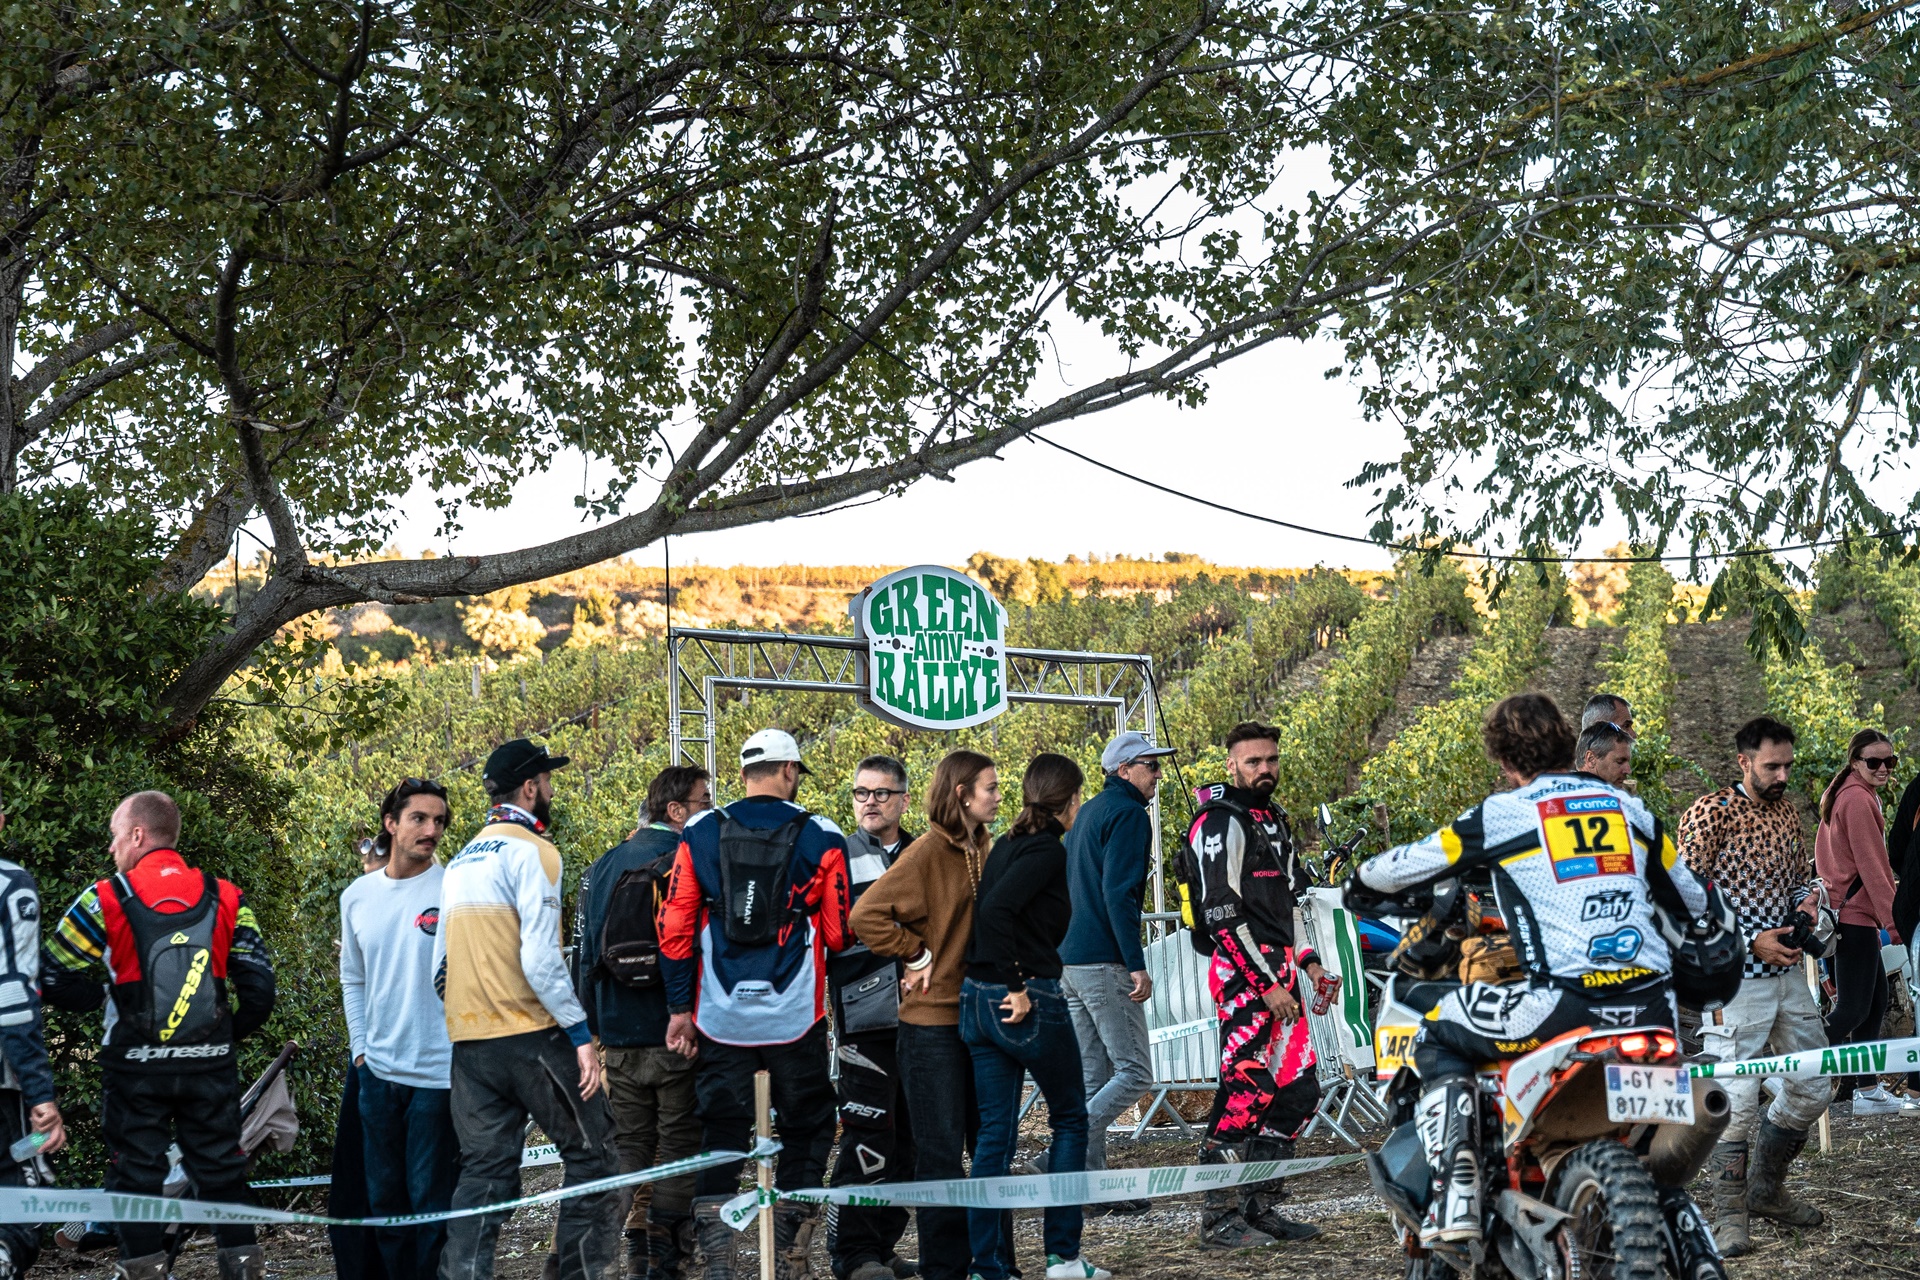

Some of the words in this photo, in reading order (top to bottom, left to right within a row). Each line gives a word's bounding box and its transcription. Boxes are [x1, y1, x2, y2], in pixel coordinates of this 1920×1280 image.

[870, 574, 1000, 643] GREEN
[914, 632, 963, 661] AMV
[874, 650, 1001, 721] RALLYE
[1568, 799, 1619, 812] aramco
[1564, 816, 1615, 855] 12
[743, 879, 756, 926] NATHAN
[1204, 903, 1237, 925] FOX
[1582, 899, 1633, 922] Dafy
[1588, 931, 1639, 960] S3
[158, 948, 210, 1042] ACERBIS
[125, 1043, 230, 1063] alpinestars
[1735, 1056, 1801, 1076] amv.fr
[1631, 1070, 1653, 1089] GY
[1616, 1096, 1647, 1116] 817
[1664, 1098, 1687, 1118] XK
